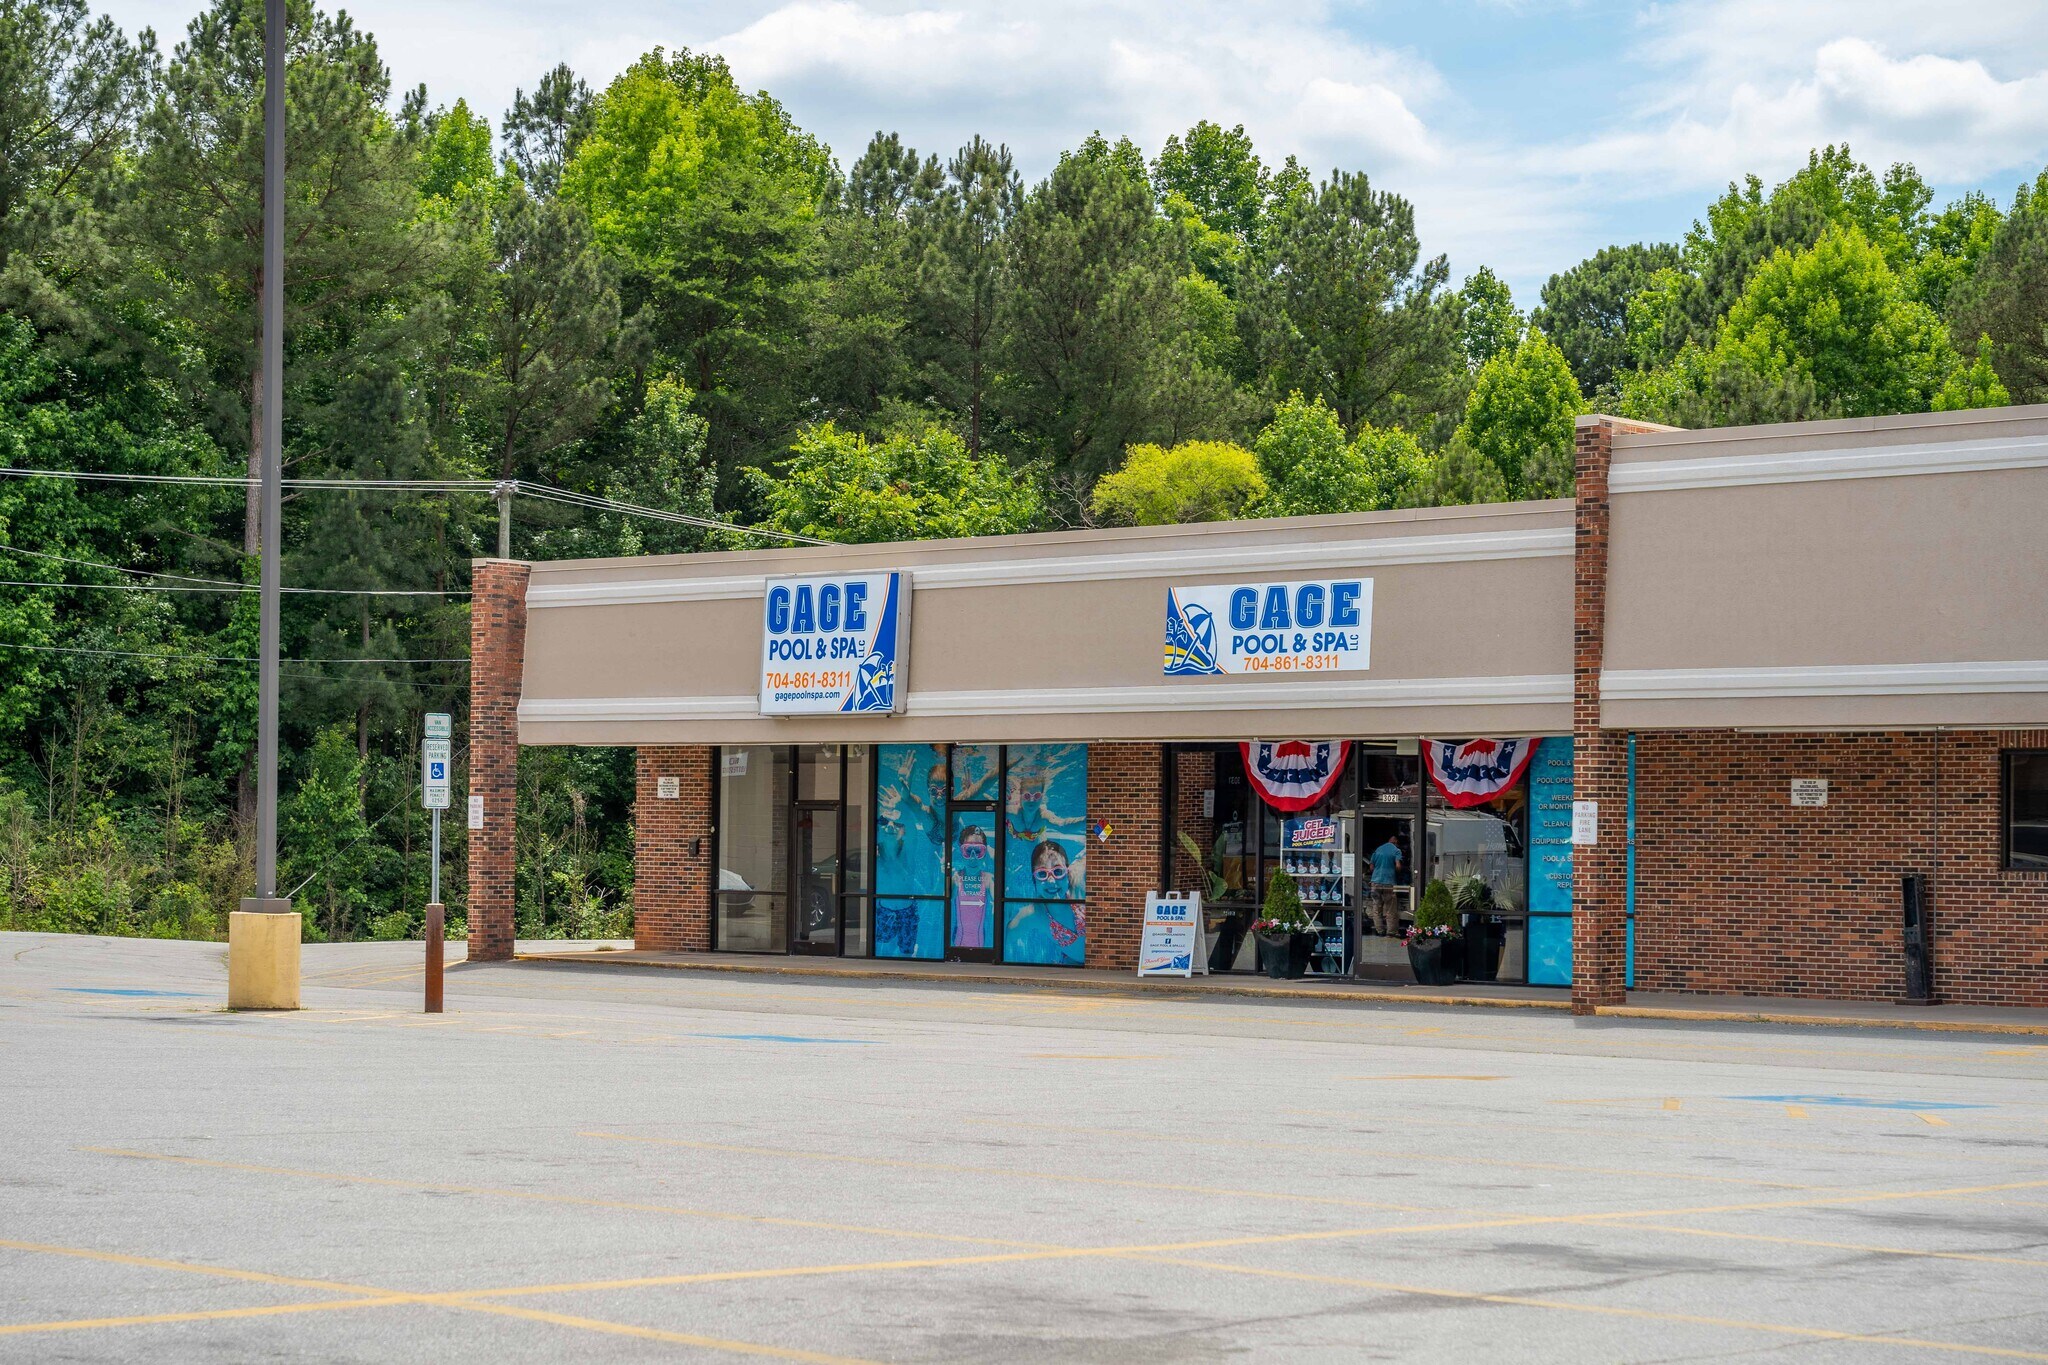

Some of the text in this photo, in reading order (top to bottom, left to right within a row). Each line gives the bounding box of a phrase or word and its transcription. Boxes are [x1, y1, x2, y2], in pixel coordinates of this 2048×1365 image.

[767, 582, 867, 634] GAGE
[1229, 582, 1361, 631] GAGE
[769, 639, 812, 660] POOL
[816, 638, 826, 659] &
[831, 637, 858, 659] SPA
[1232, 632, 1359, 654] POOL & SPA LLC
[1244, 654, 1338, 671] 704-861-8311
[766, 671, 850, 689] 704-861-8311
[1292, 825, 1334, 842] JUICED!
[1306, 820, 1323, 830] GET
[1157, 906, 1186, 915] GAGE
